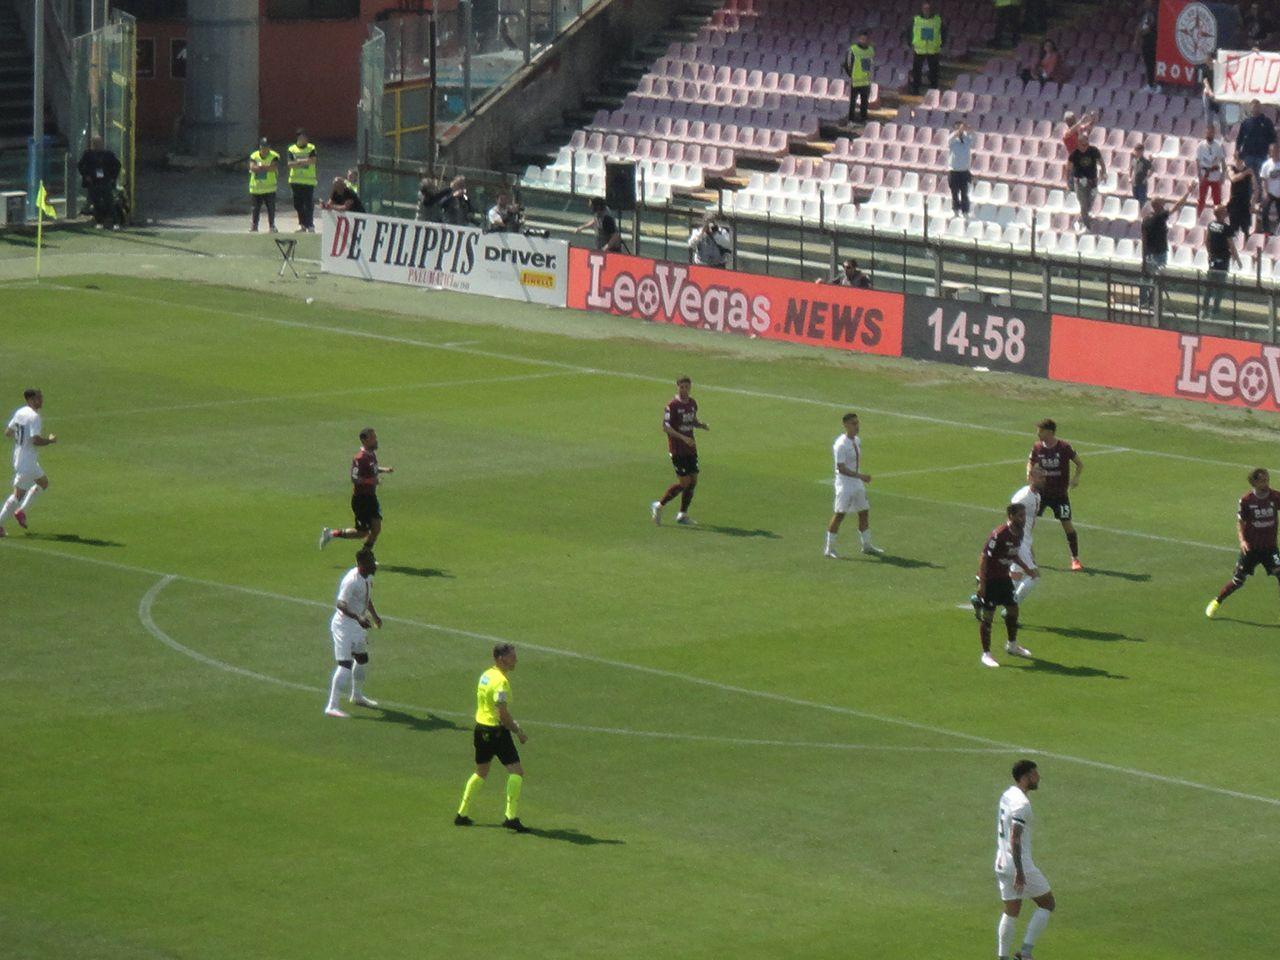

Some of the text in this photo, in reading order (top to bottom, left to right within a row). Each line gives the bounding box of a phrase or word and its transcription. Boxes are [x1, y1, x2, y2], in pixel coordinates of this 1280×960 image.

[330, 215, 481, 276] DE FILIPPIS
[586, 254, 772, 333] LeoVegas
[927, 307, 1026, 364] 14:58
